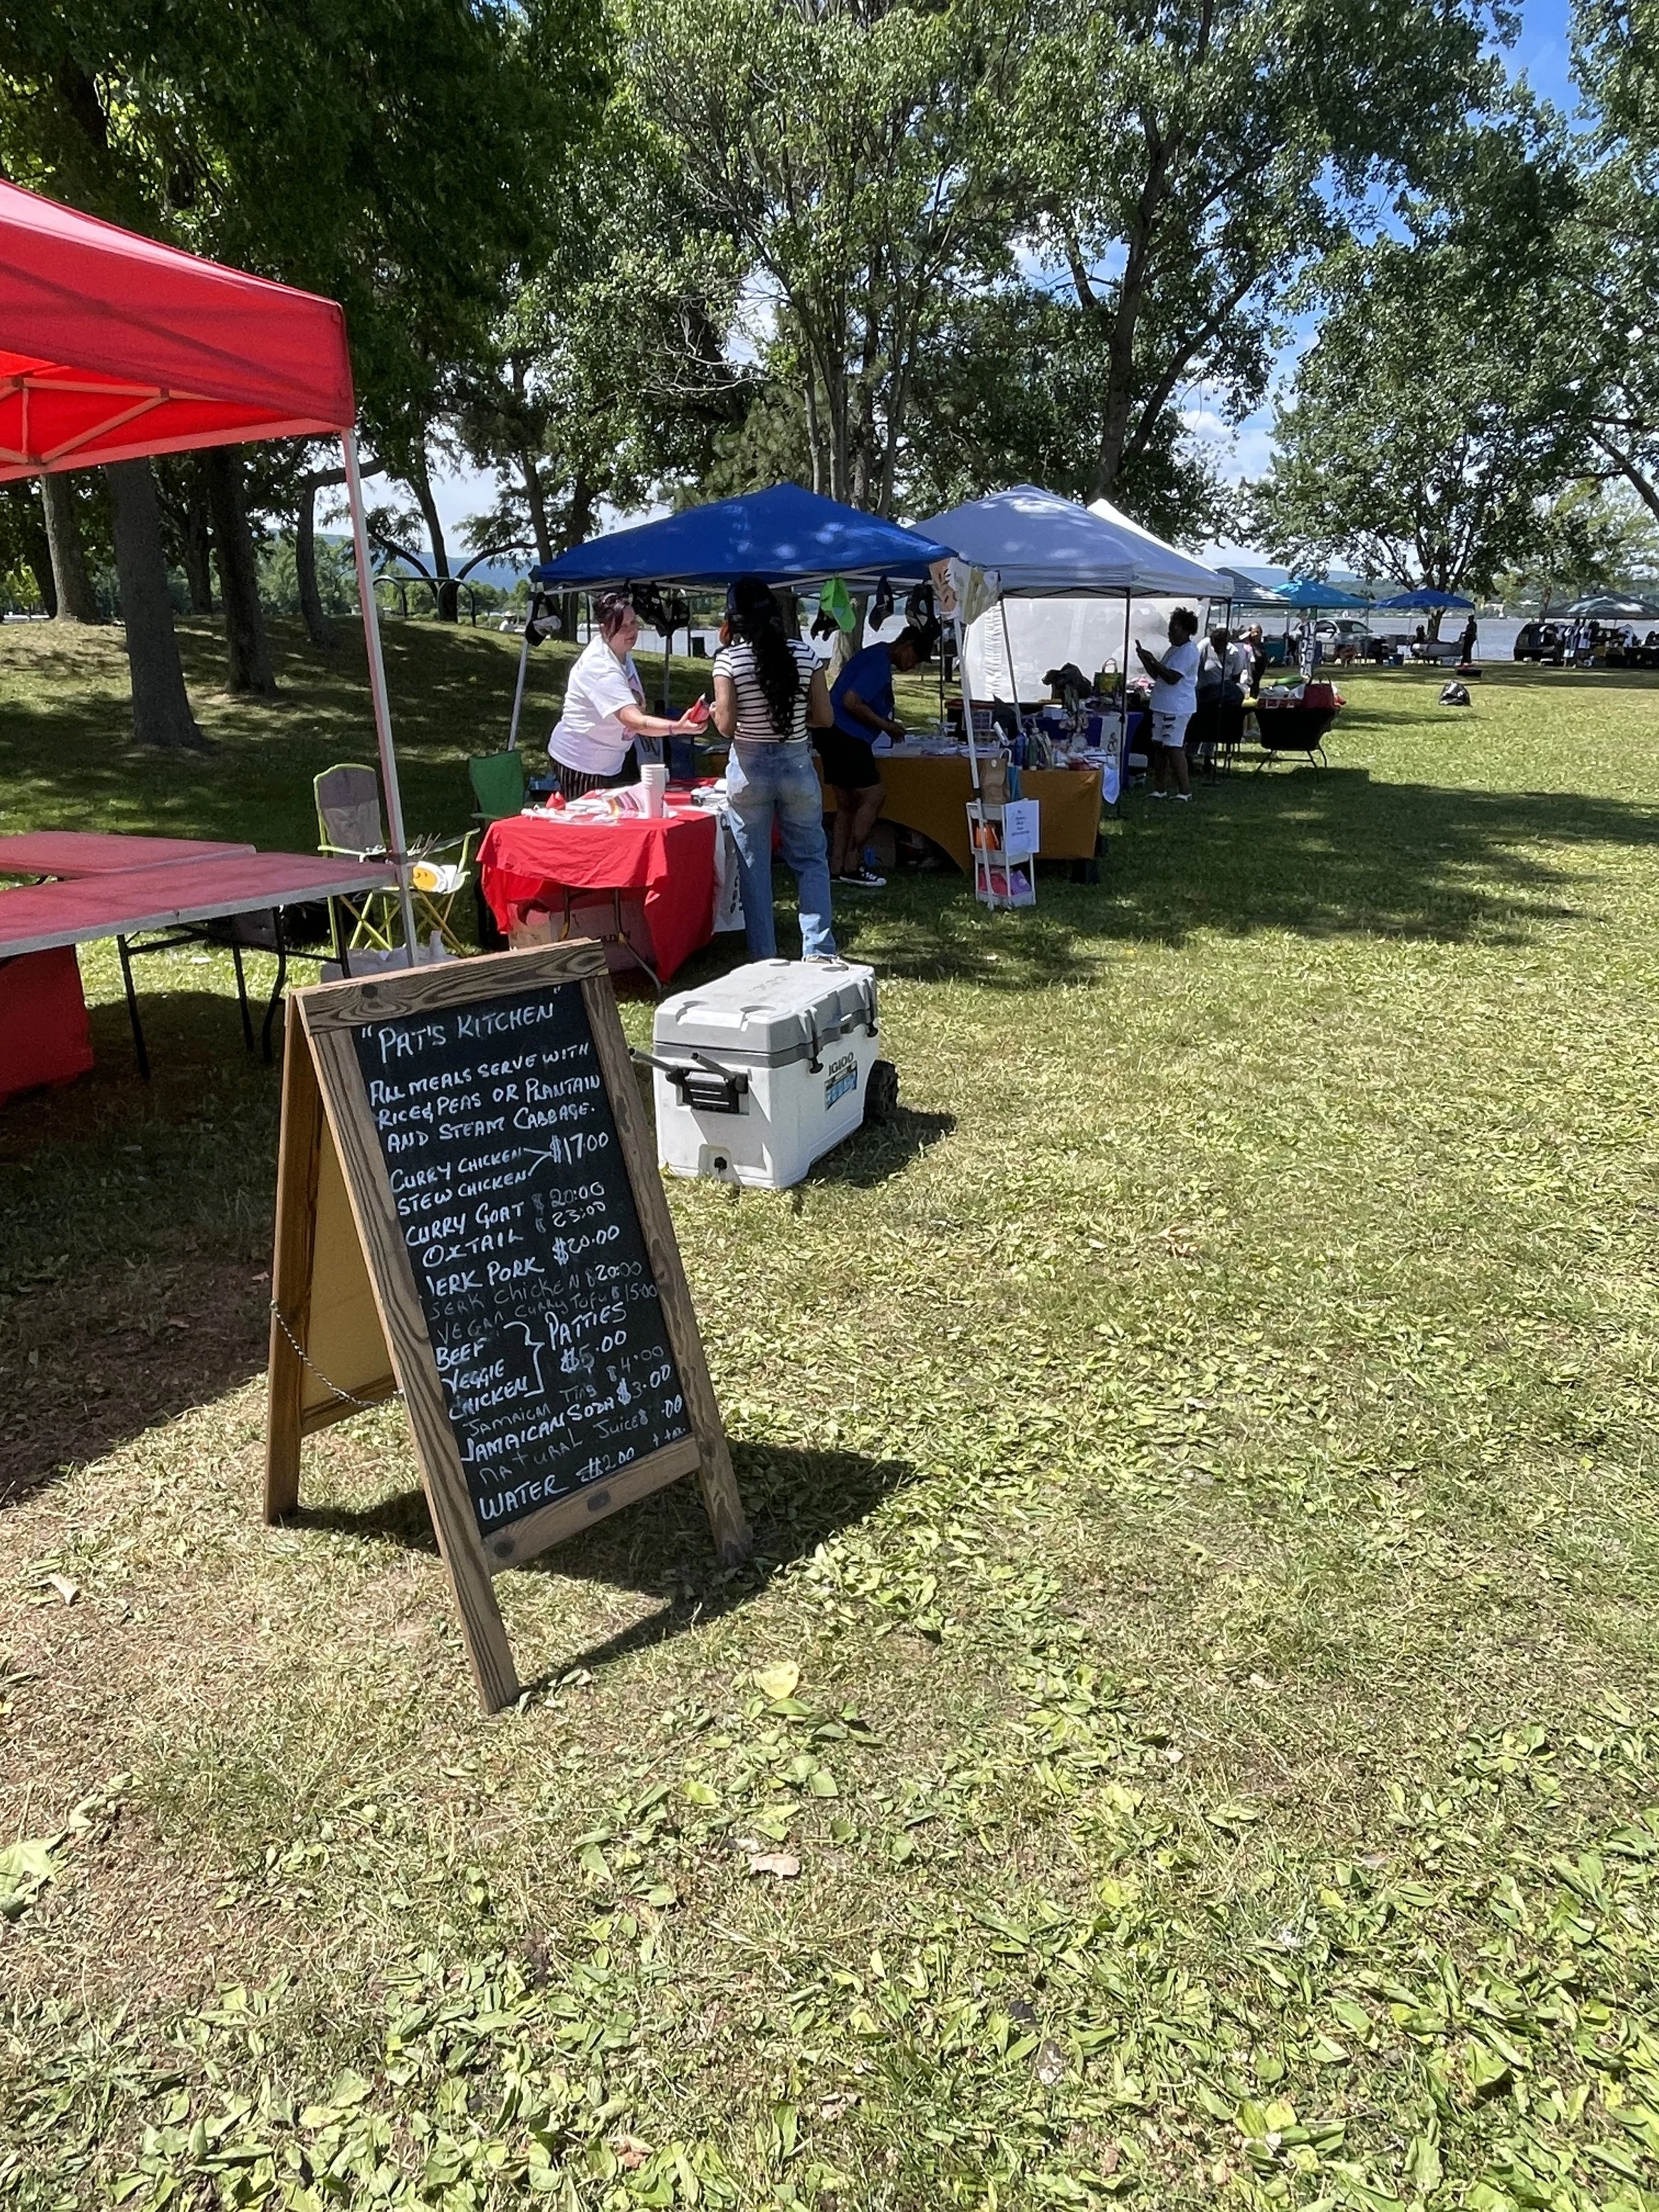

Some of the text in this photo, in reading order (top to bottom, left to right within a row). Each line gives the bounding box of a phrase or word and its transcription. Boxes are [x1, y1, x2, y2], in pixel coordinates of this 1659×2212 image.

[409, 1068, 472, 1095] MEALS
[477, 1054, 538, 1078] SERVE
[542, 1042, 589, 1063] WITH
[492, 1084, 519, 1102] OR
[525, 1074, 601, 1103] PLANTAIN
[388, 1102, 595, 1153] AND STEAM CABBAGE.
[390, 1146, 522, 1193] CURRY CHICKEN
[397, 1169, 527, 1216] STEW CHICKEN
[405, 1213, 467, 1246] CURRY
[475, 1201, 525, 1229] GOAT
[422, 1228, 524, 1268] OXTAIL
[486, 1256, 546, 1286] PORK
[551, 1225, 620, 1266] $20.00
[544, 1301, 627, 1351] PATTIES
[435, 1337, 488, 1372] BEEF
[441, 1359, 505, 1394] VEGGIE
[449, 1376, 528, 1421] CHICKEN
[460, 1412, 565, 1463] JAMAICAN
[566, 1396, 616, 1422] SODA
[479, 1473, 570, 1520] WATER
